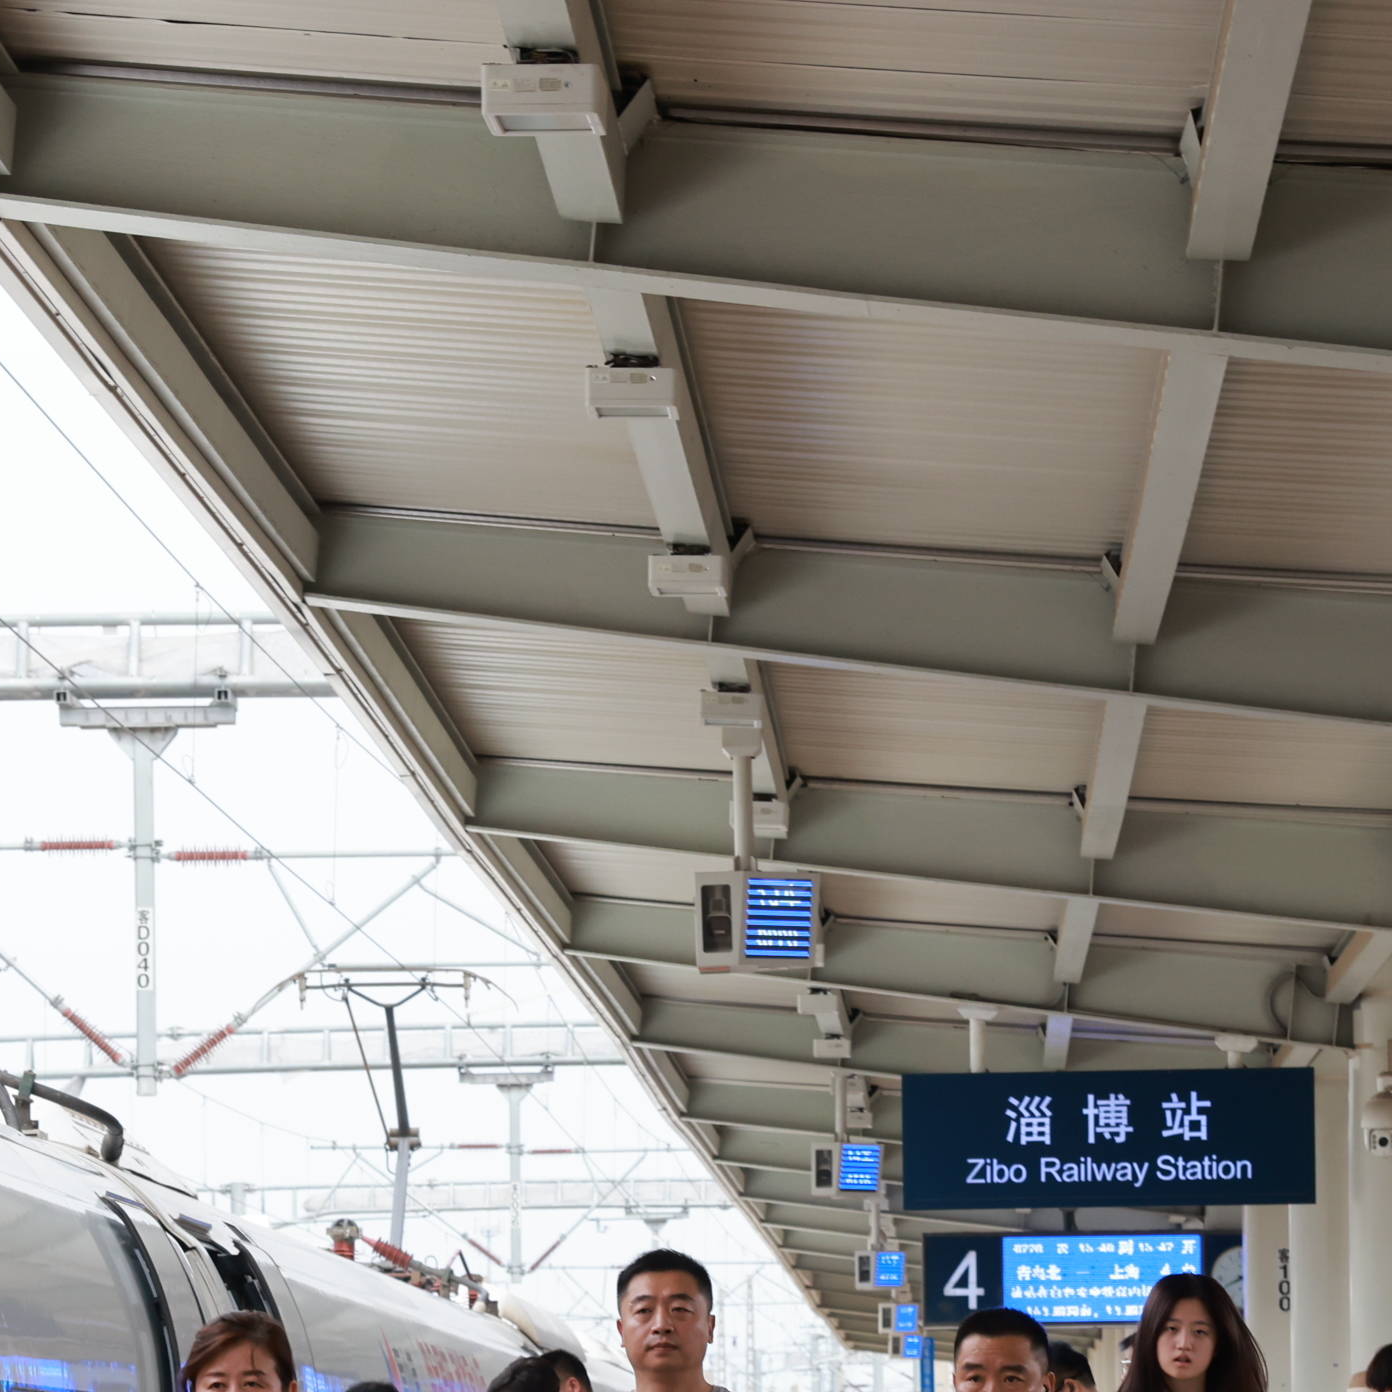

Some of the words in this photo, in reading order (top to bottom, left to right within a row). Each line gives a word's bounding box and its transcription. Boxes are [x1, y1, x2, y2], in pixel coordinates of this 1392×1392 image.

[1005, 1091, 1211, 1145] 淄博站
[966, 1158, 1027, 1183] Zibo
[1039, 1156, 1149, 1187] Railway
[1156, 1154, 1252, 1181] Station
[943, 1250, 985, 1309] 4
